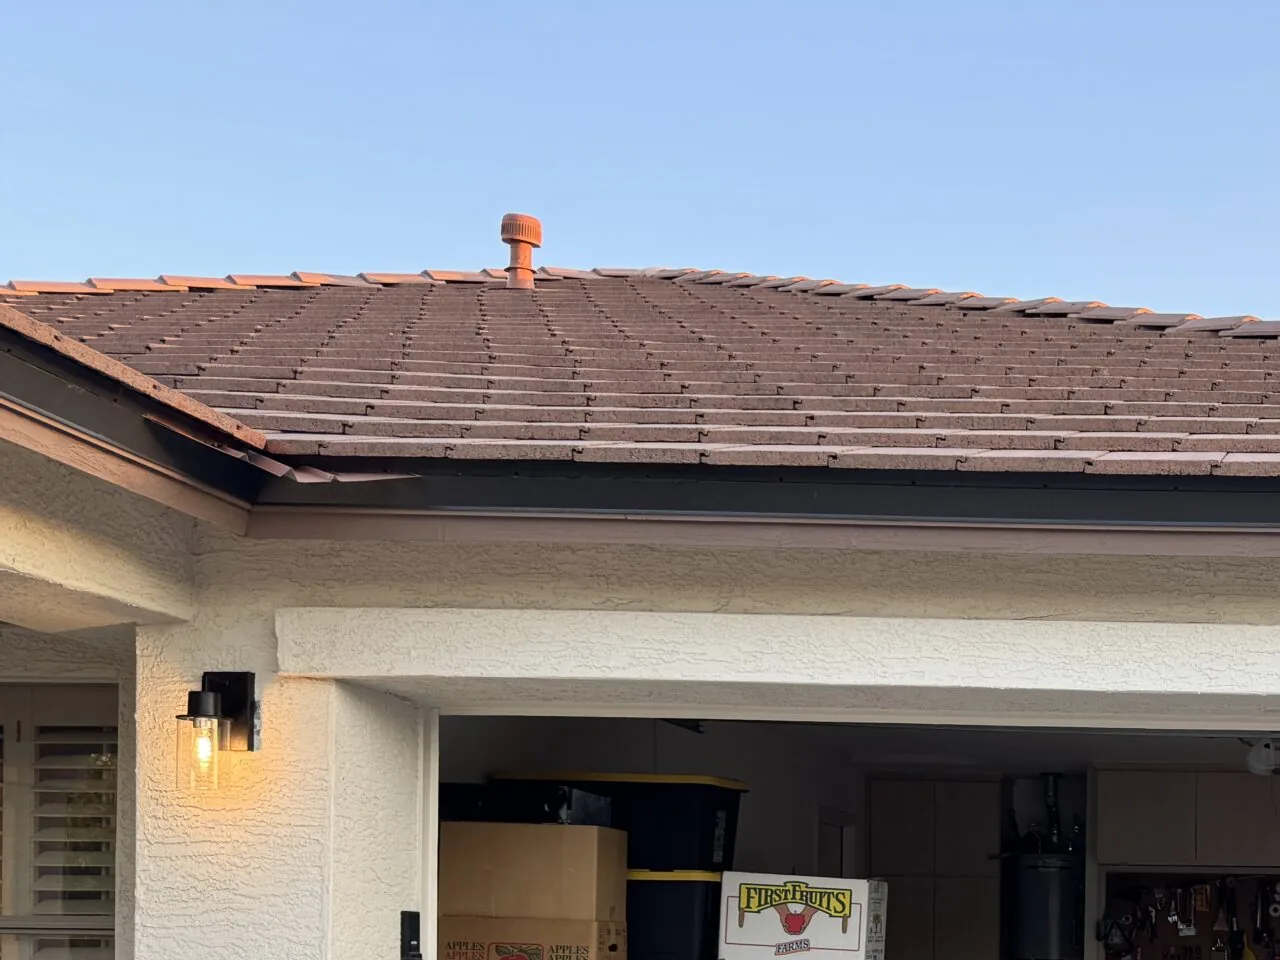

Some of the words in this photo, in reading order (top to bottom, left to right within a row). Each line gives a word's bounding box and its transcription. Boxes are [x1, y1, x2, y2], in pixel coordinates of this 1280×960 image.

[444, 942, 486, 951] APPLES
[548, 945, 590, 954] APPLES
[776, 939, 809, 954] FARMS
[443, 951, 485, 960] APPLES
